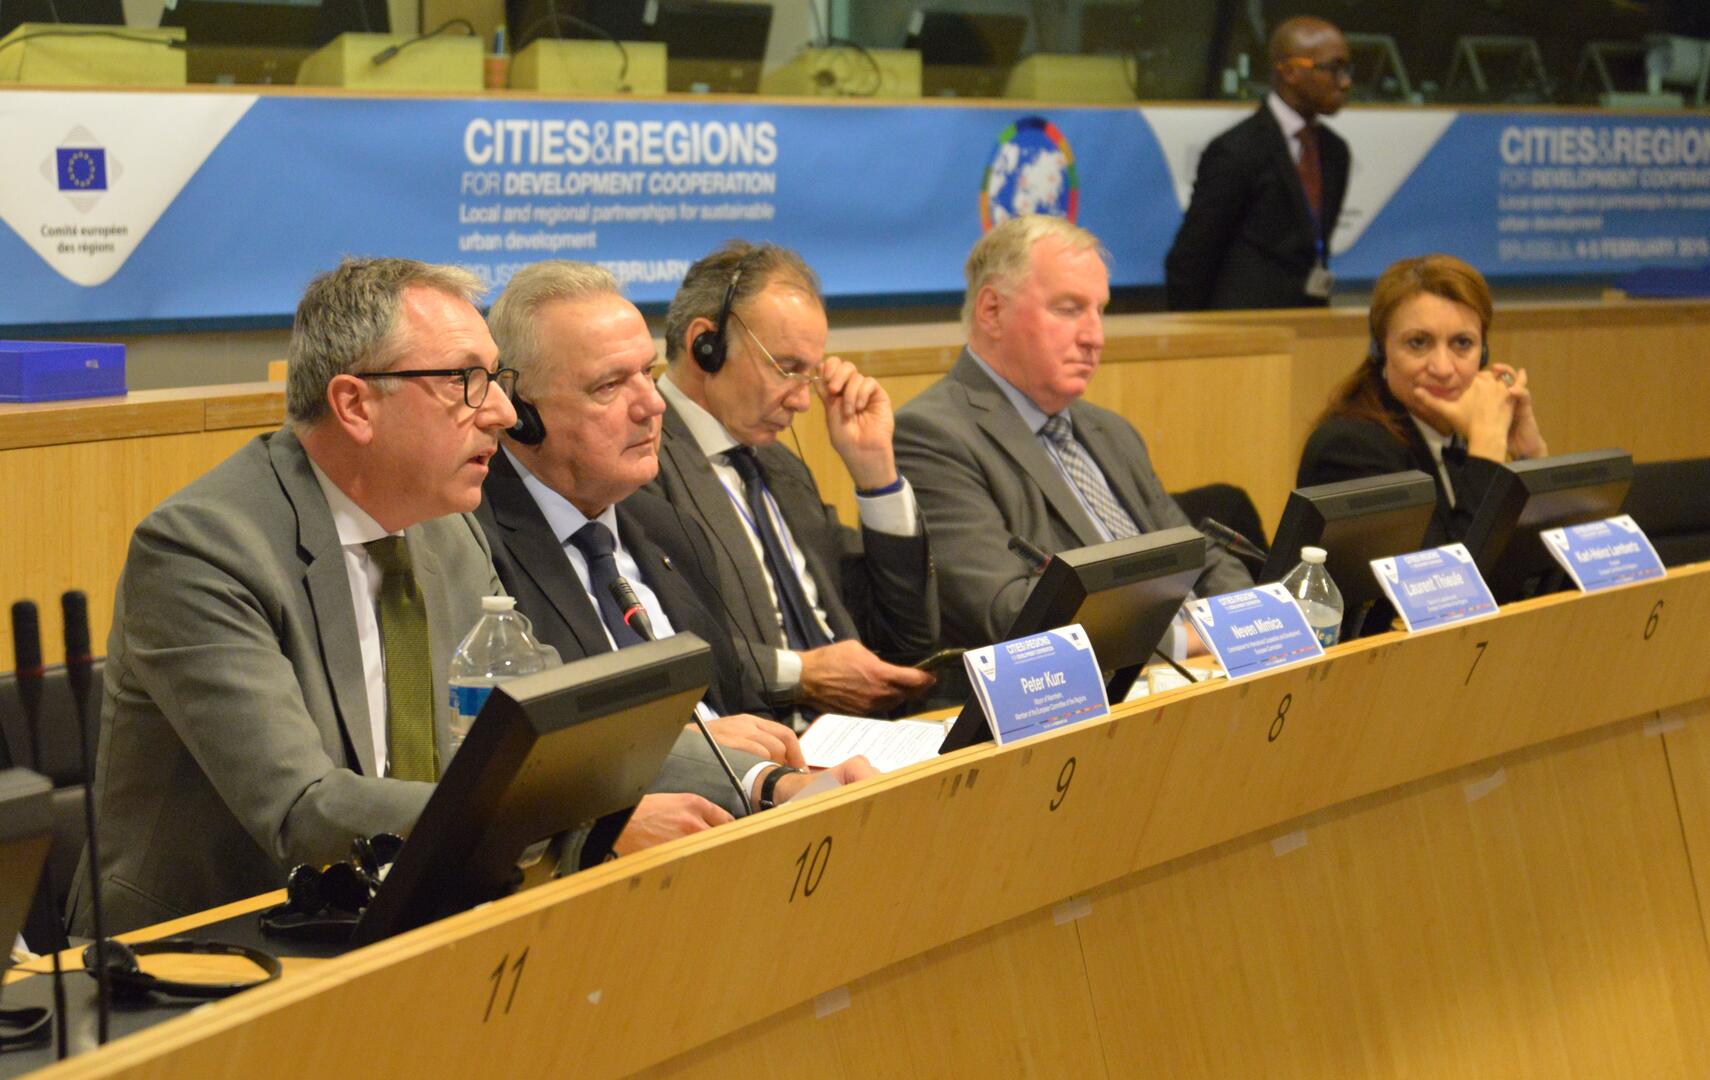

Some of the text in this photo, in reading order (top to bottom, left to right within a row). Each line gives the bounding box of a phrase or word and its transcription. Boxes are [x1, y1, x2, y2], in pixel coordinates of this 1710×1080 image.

[463, 118, 778, 165] CITIES&REGIONS
[461, 171, 777, 196] FOR DEVELOPMENT COOPERATION
[458, 202, 775, 227] Local and regional partnerships for sustainable
[41, 223, 129, 239] Comité européen
[458, 229, 596, 252] urban development
[57, 241, 115, 257] des régions
[1230, 616, 1285, 640] Neven Mimica
[1644, 600, 1663, 640] 6
[1465, 641, 1488, 686] 7
[1020, 670, 1067, 694] Peter Kurz
[1268, 693, 1292, 742] 8
[1049, 757, 1076, 811] 9
[788, 836, 832, 903] 10
[483, 946, 530, 1024] 11
